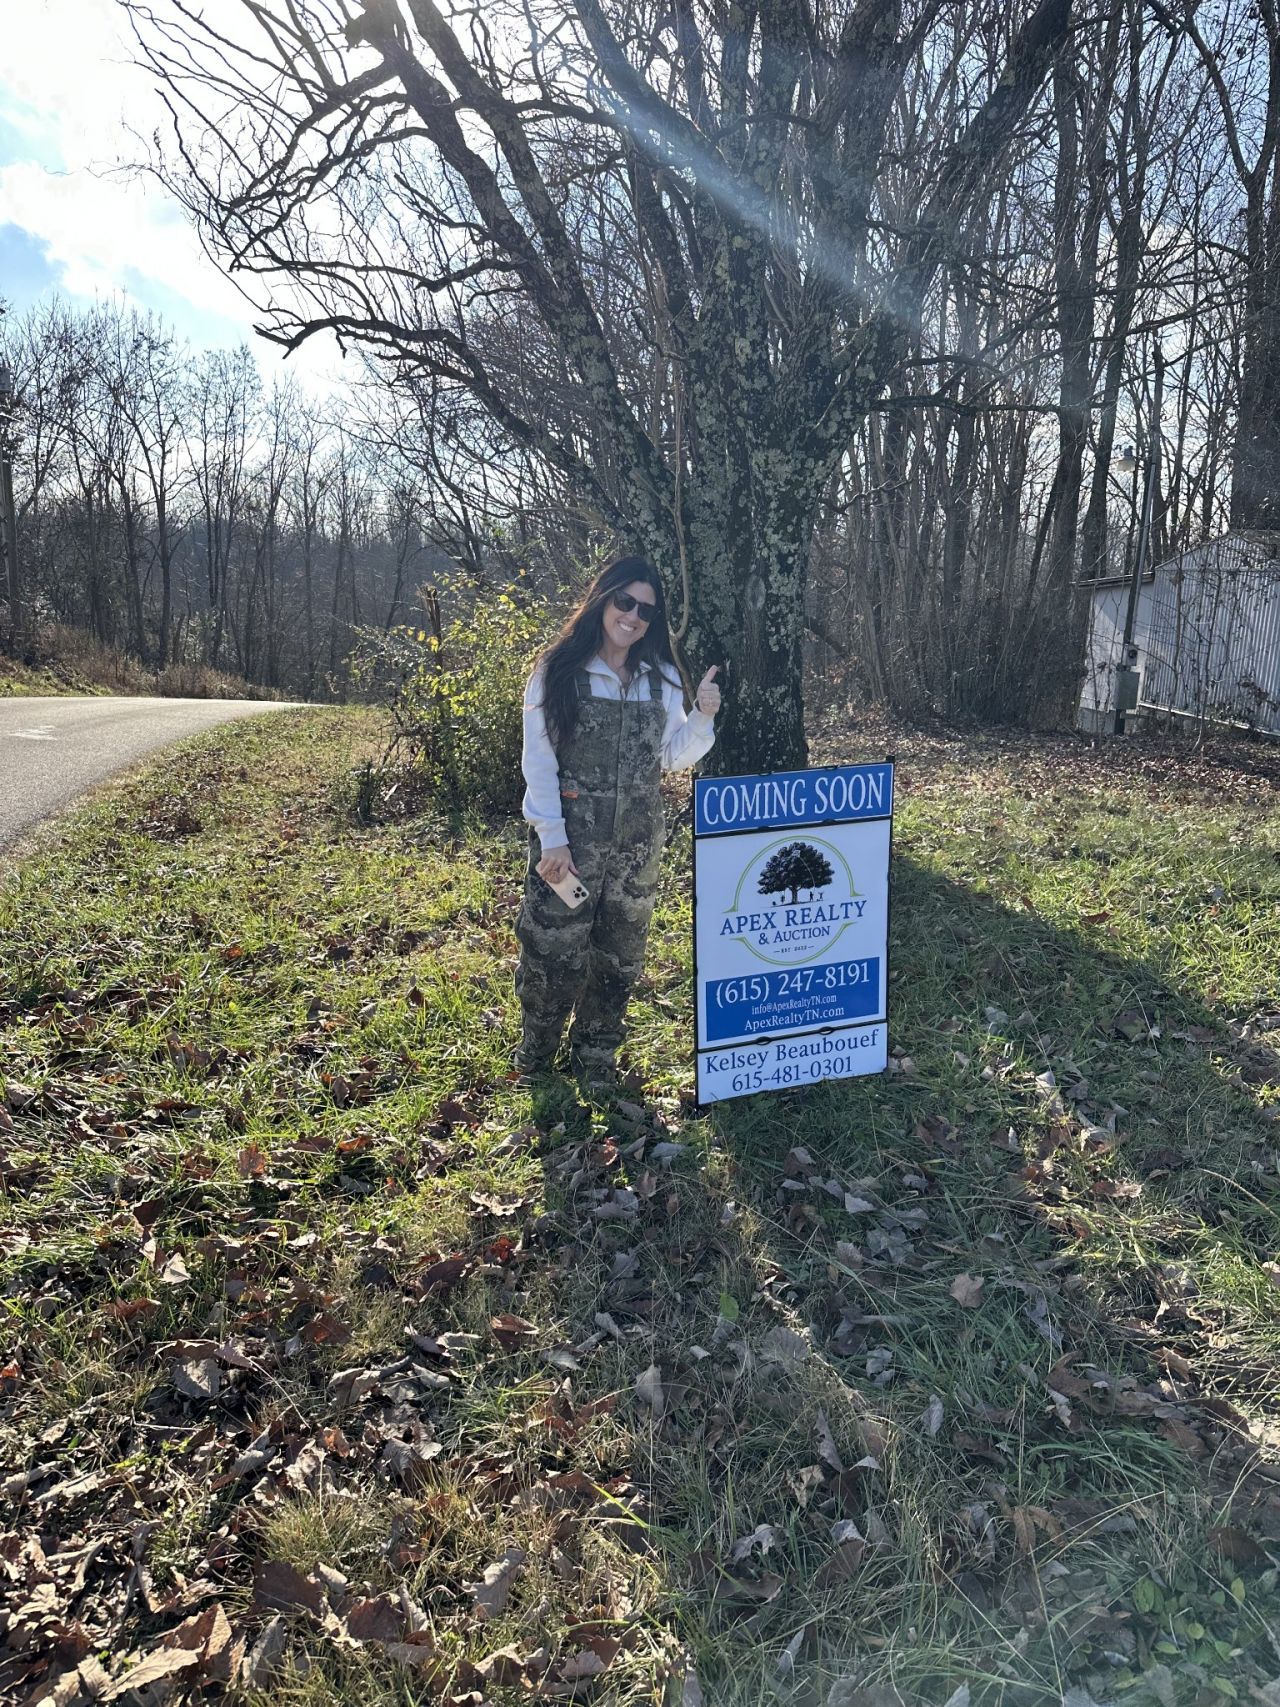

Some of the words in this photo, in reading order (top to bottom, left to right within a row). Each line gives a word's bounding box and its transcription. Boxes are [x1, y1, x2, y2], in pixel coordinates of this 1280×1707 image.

[703, 777, 807, 826] COMING
[814, 772, 885, 815] SOON
[720, 910, 778, 936] APEX
[785, 900, 868, 927] REALTY
[758, 932, 770, 945] &
[773, 925, 831, 943] AUCTION
[716, 974, 770, 1008] (615)
[777, 961, 870, 996] 247-8191
[744, 1006, 845, 1032] ApexRealtyTN.com
[751, 993, 837, 1016] info@ApexRealtyTN.com
[705, 1047, 769, 1075] Kelsey
[775, 1029, 880, 1062] Beaubouef
[732, 1056, 853, 1092] 615-481-0301
